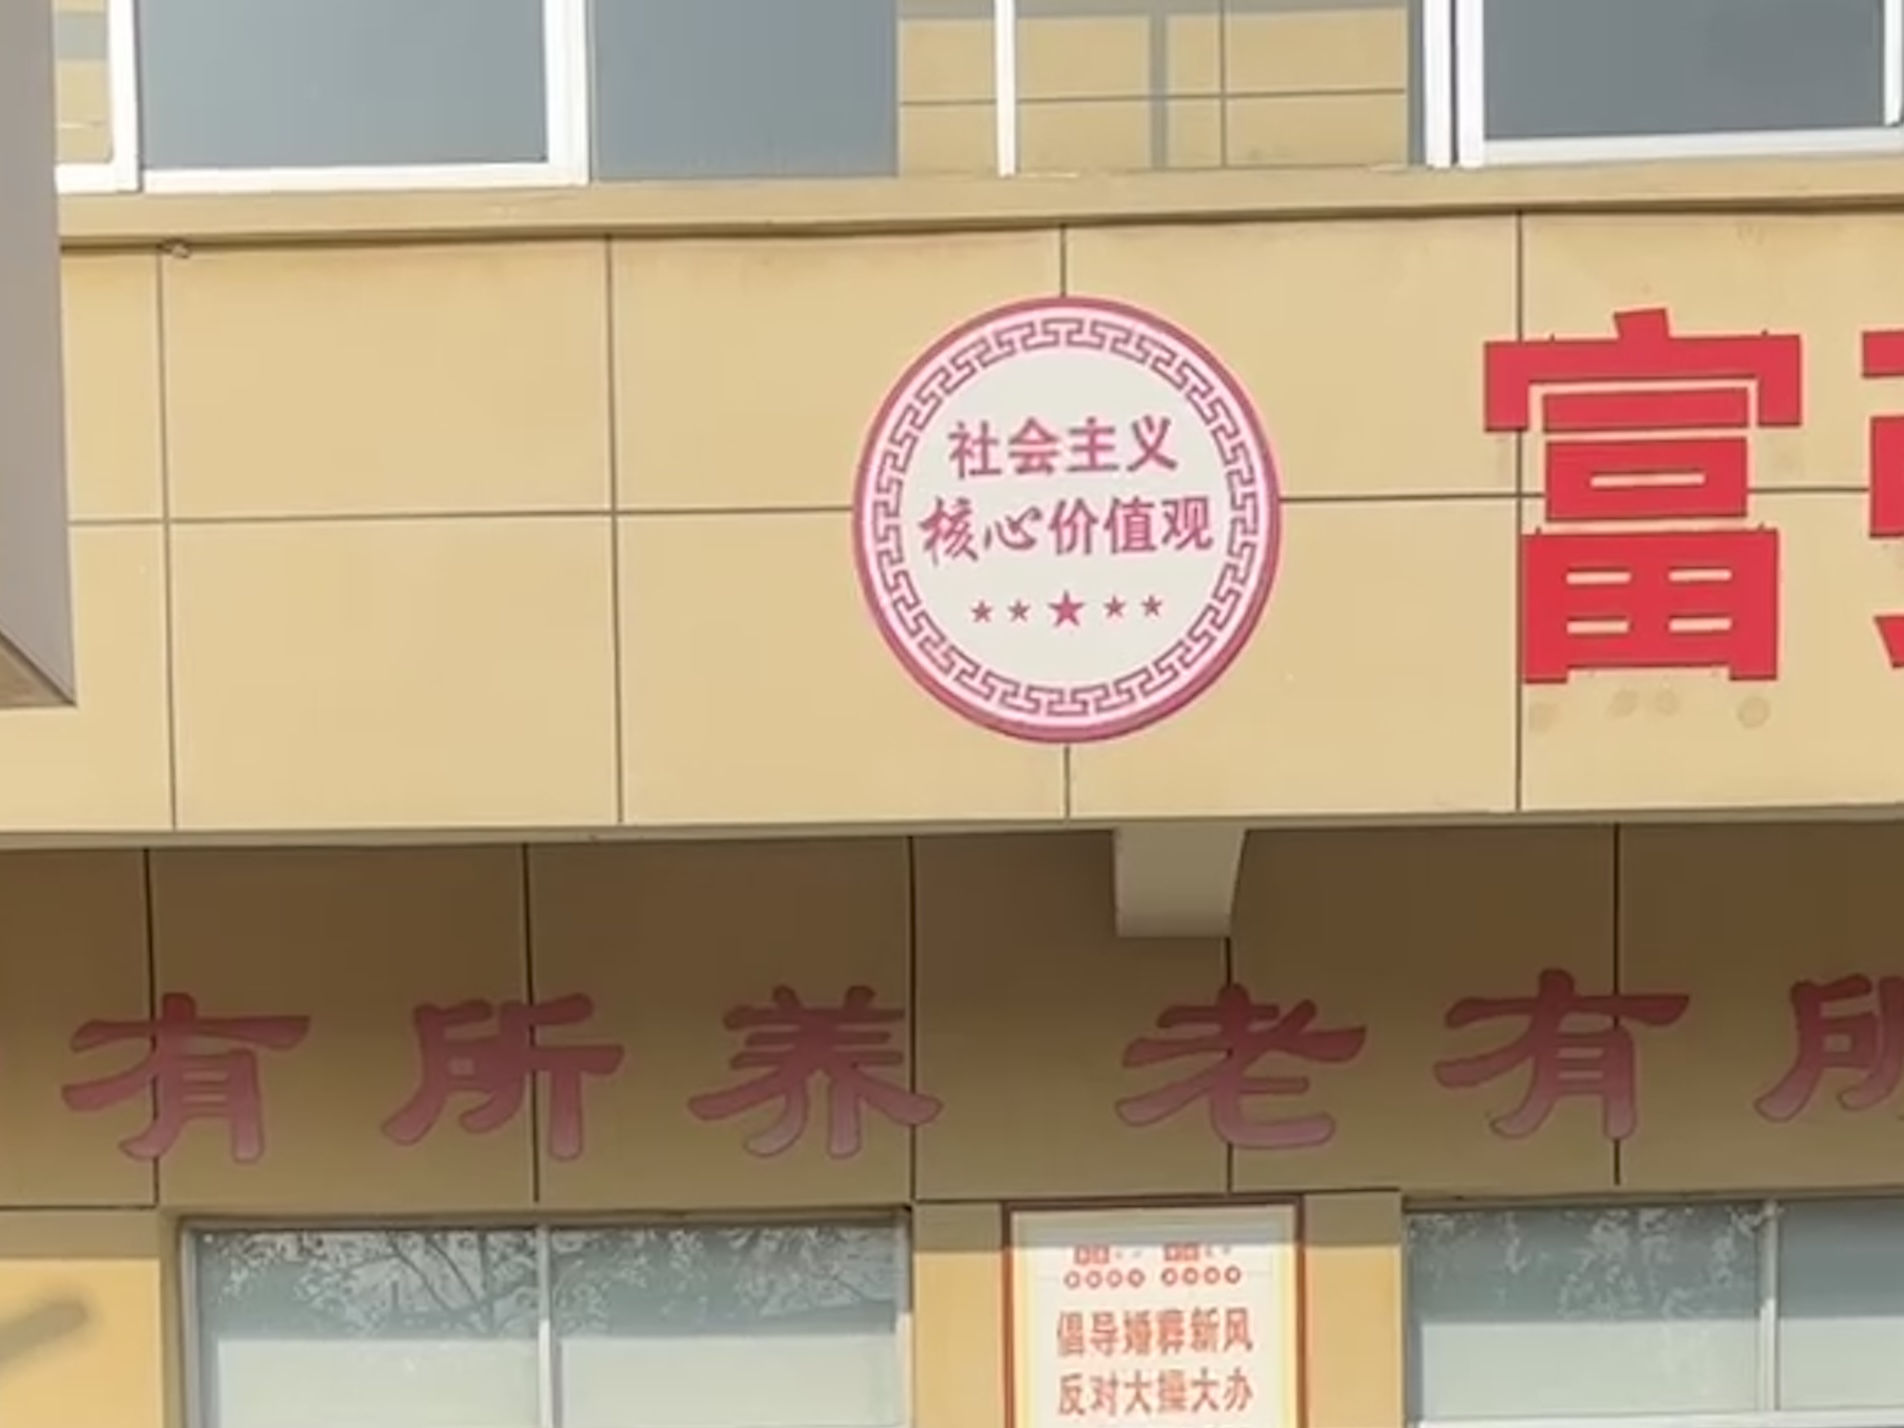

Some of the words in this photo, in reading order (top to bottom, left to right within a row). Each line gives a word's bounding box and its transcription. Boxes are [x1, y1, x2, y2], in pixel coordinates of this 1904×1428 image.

[947, 412, 1181, 481] 社会主义
[918, 492, 1216, 566] 核心价值观
